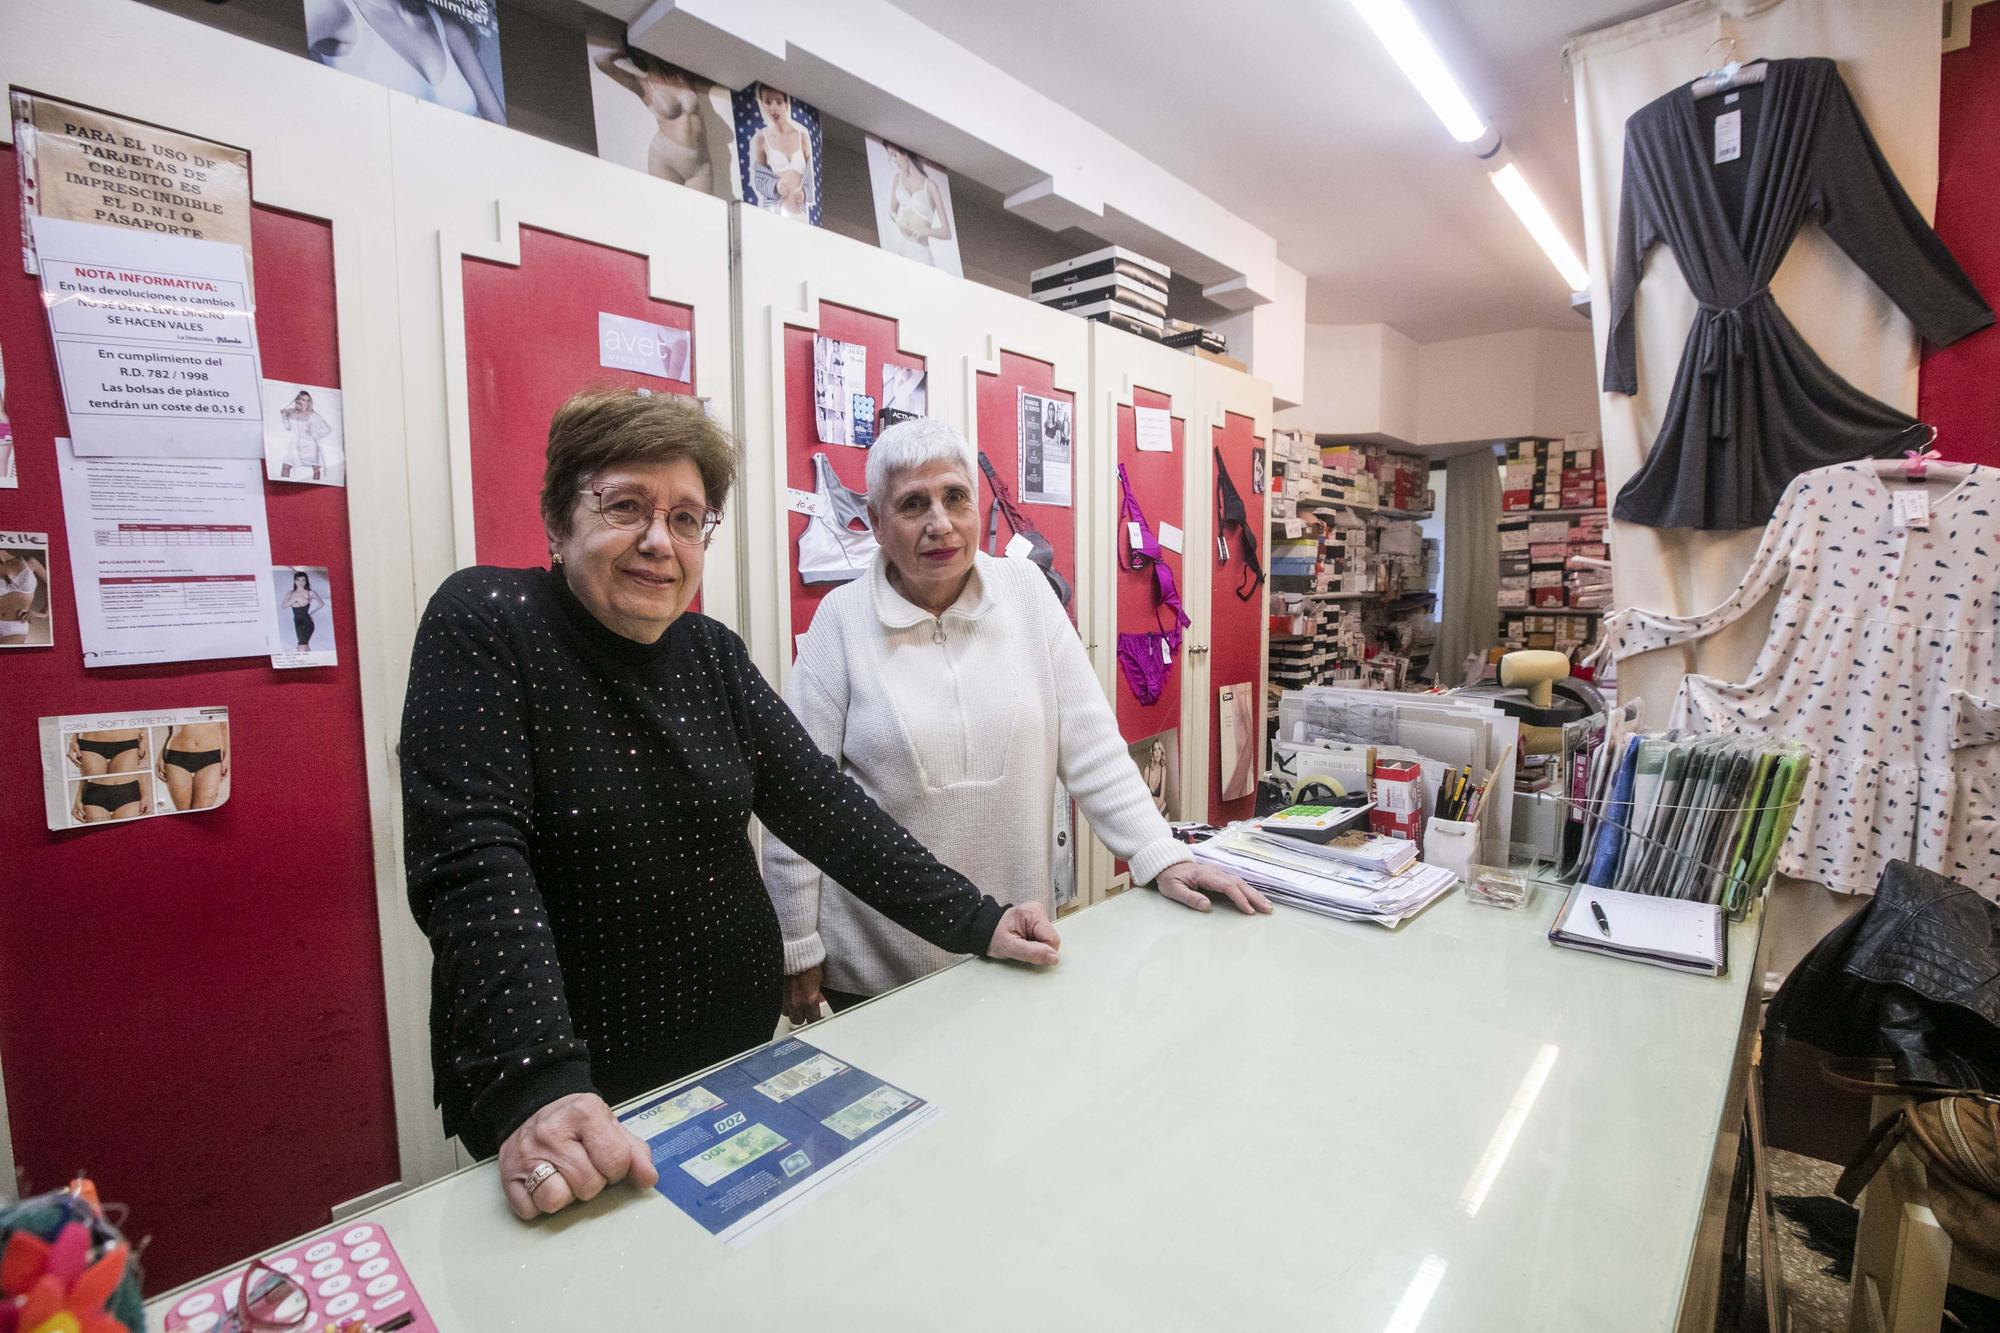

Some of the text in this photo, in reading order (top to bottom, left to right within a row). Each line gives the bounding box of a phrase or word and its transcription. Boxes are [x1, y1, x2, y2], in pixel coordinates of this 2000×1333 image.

[64, 123, 216, 171] PARA EL USO DE
[80, 143, 177, 175] TARJETAS
[65, 171, 224, 215] IMPRESCINDIBLE
[180, 180, 202, 195] ES
[102, 195, 127, 210] EL
[181, 212, 194, 224] O
[94, 208, 204, 240] PASAPORTE
[75, 267, 218, 292] NOTA INFORMATIVA:
[60, 281, 76, 291] En
[78, 283, 96, 292] las
[98, 286, 177, 302] devoluciones
[190, 297, 236, 308] cambios
[107, 315, 204, 332] SE HACEN VALES
[606, 330, 668, 360] avet
[98, 349, 222, 366] En cumplimiento del
[120, 367, 144, 378] R.D.
[148, 369, 170, 379] 782
[180, 372, 209, 381] 1998
[102, 383, 122, 392] Las
[126, 384, 164, 395] bolsas
[168, 386, 182, 396] de
[88, 400, 245, 414] tendrán un coste de 0,15 €
[97, 720, 125, 729] SOFT
[128, 716, 177, 726] STRETCH
[801, 1071, 827, 1087] 200
[639, 1105, 666, 1120] 200
[872, 1105, 898, 1120] 100
[716, 1113, 744, 1132] 200
[701, 1146, 726, 1161] 100
